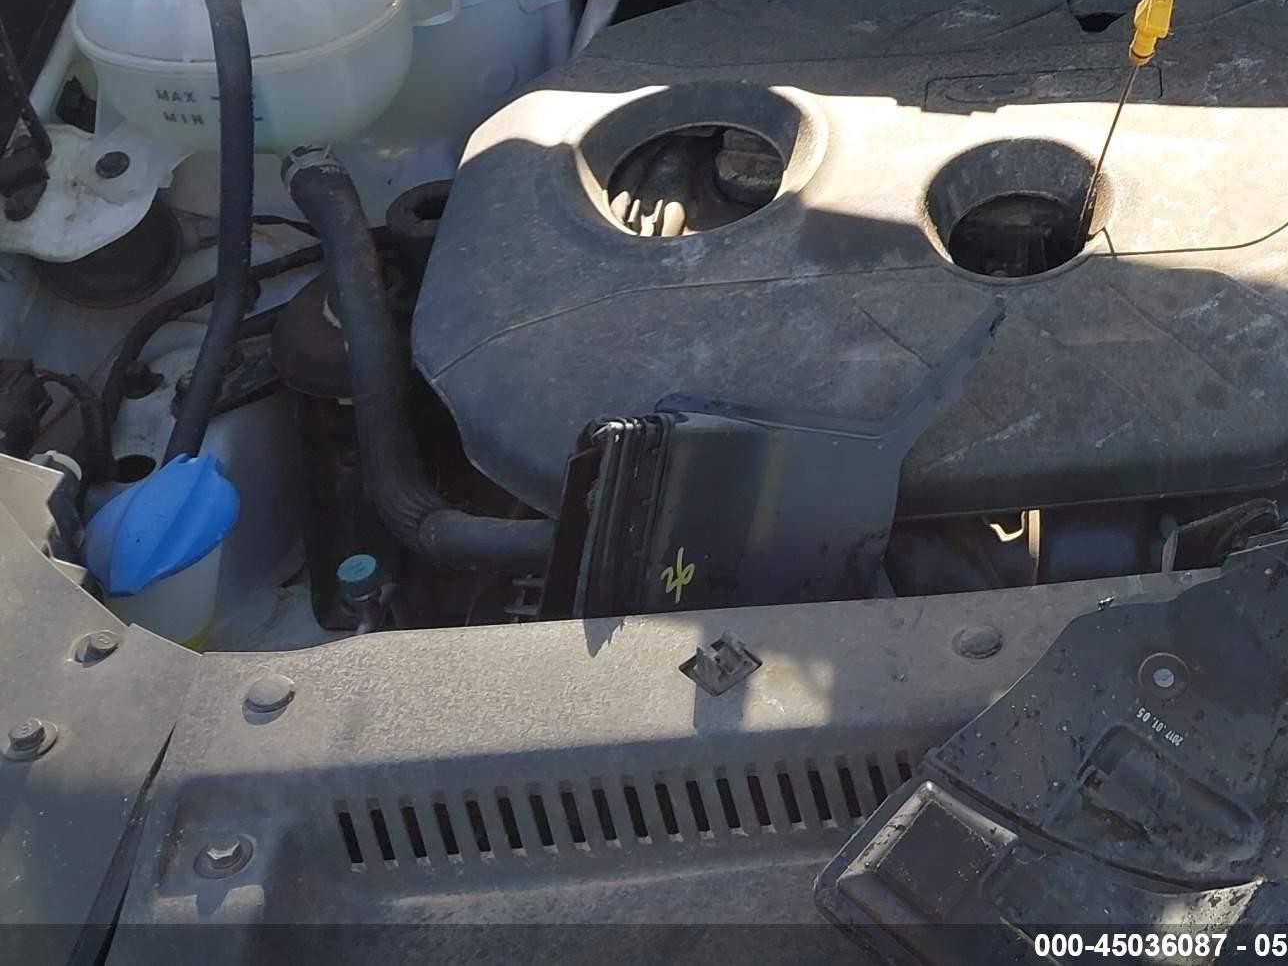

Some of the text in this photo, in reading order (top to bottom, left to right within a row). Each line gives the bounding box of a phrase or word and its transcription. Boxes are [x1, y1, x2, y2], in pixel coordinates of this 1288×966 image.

[156, 89, 196, 104] MAX
[163, 112, 205, 126] MIN
[1136, 706, 1151, 722] 05
[1165, 729, 1184, 746] 2017
